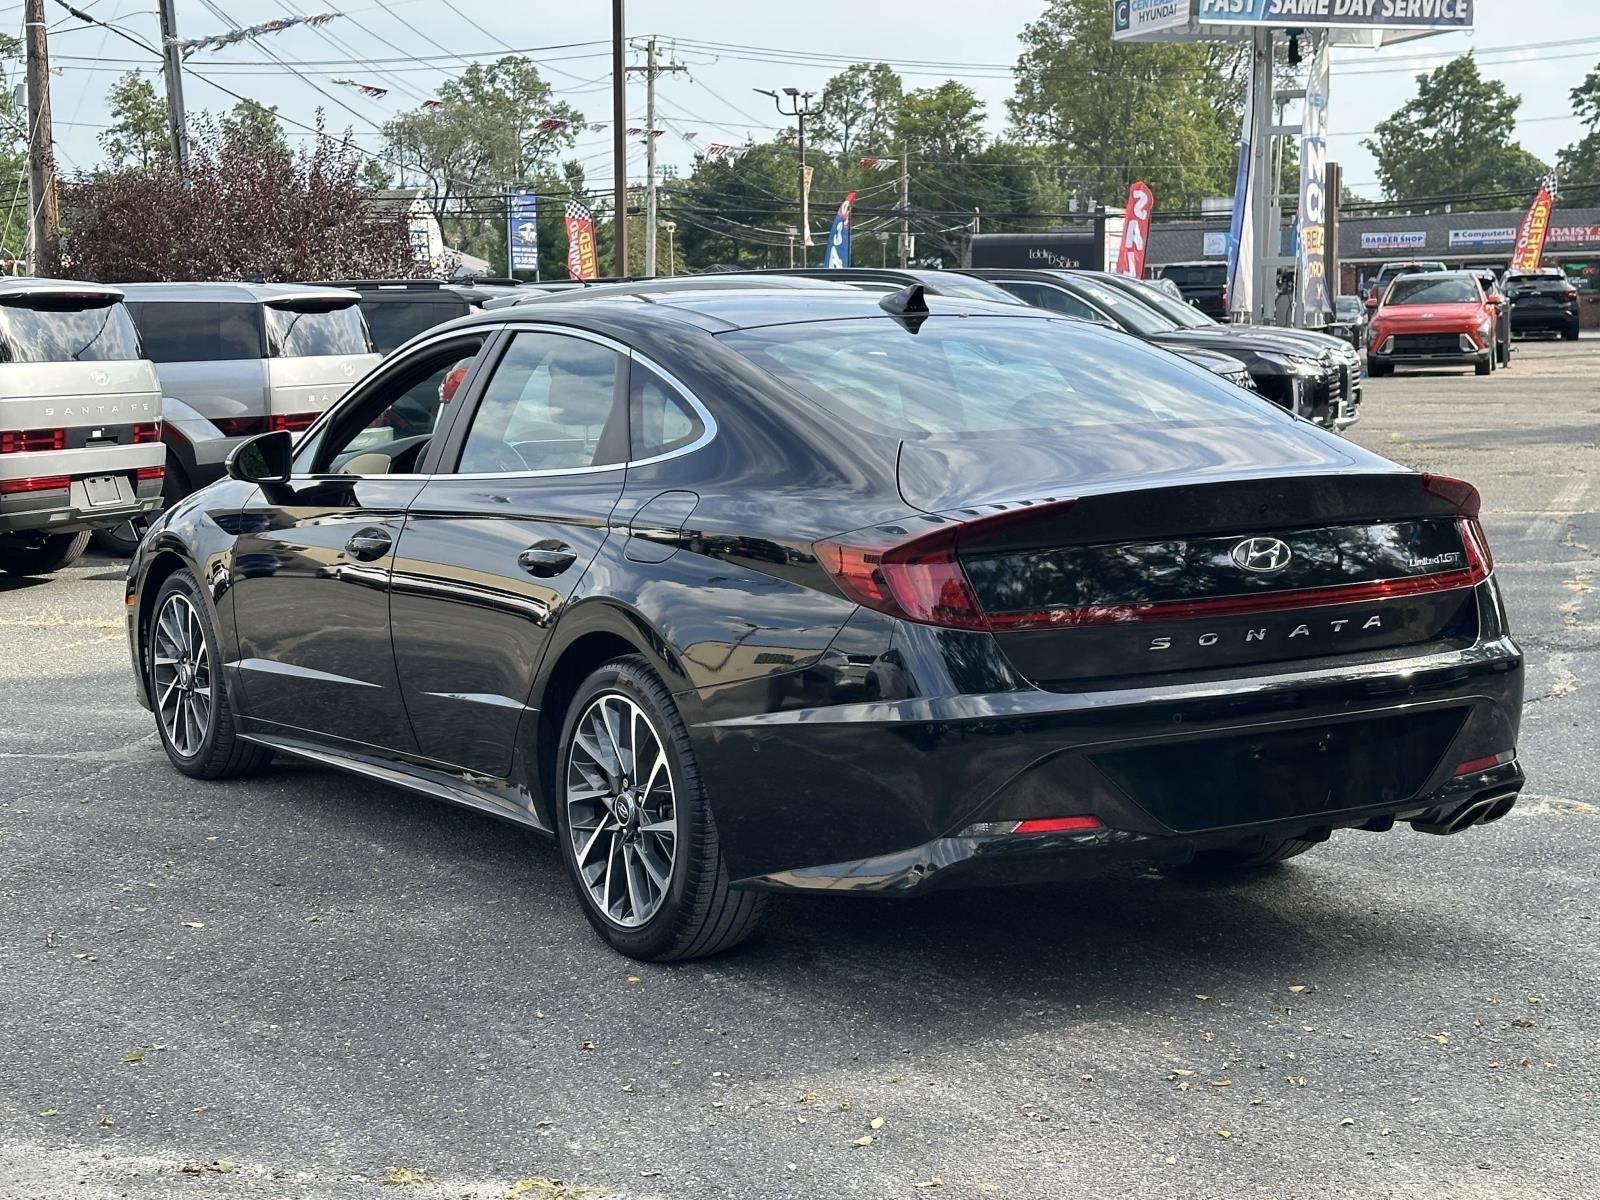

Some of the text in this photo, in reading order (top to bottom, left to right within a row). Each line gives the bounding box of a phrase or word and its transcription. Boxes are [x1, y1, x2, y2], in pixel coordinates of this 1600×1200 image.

[1139, 3, 1177, 23] HYUNDAI
[1202, 0, 1468, 19] FAST SAME DAY SERVICE
[1550, 226, 1593, 236] DAISY
[45, 403, 149, 417] SANTA FE
[1409, 555, 1440, 567] Limited
[1149, 614, 1383, 651] SONATA
